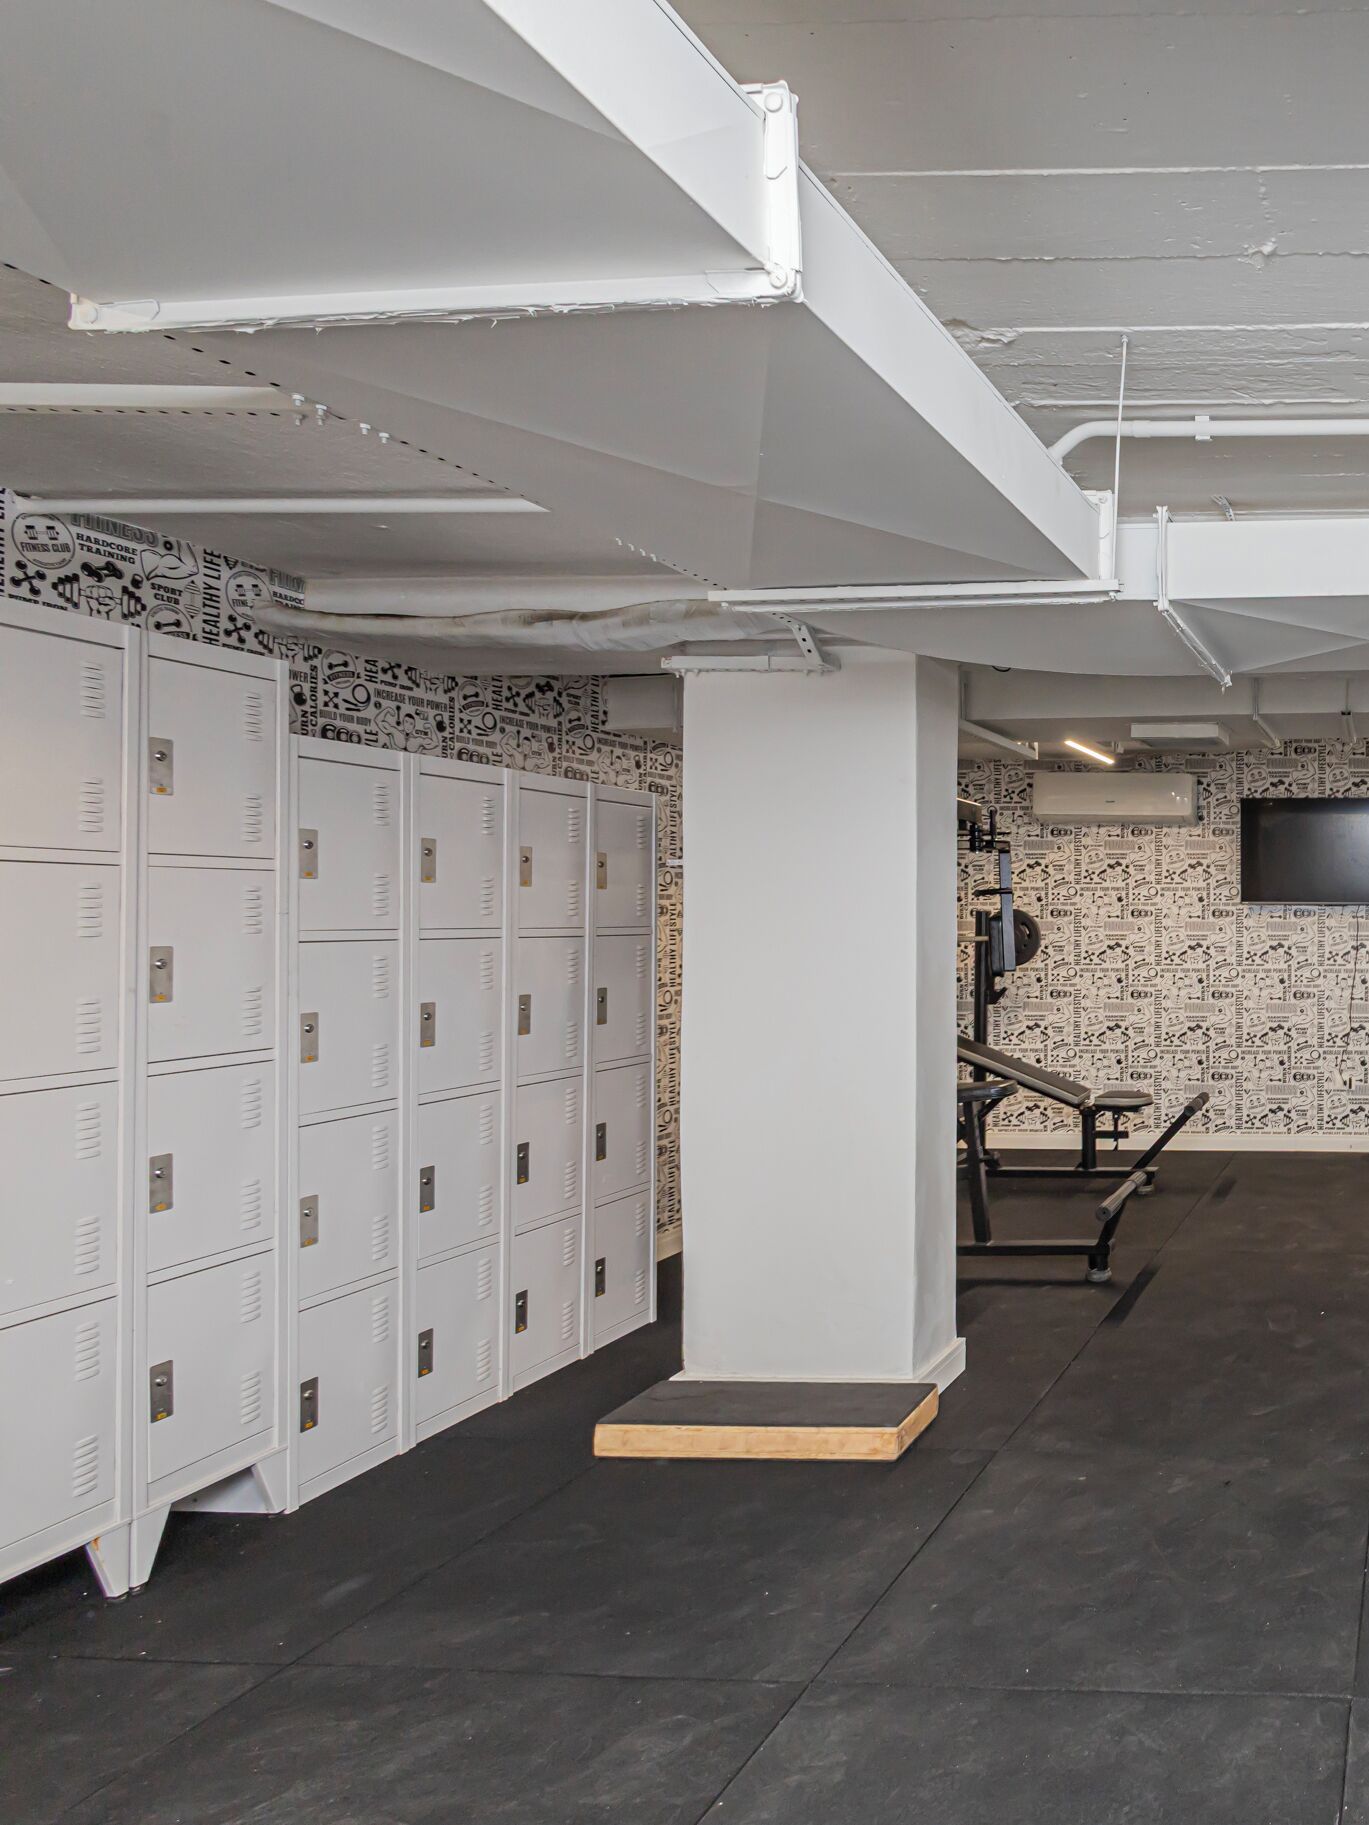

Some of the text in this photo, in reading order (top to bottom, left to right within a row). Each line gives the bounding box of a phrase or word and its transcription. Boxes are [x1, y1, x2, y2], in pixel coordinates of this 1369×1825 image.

[20, 542, 71, 553] FITNESS CLUB
[76, 532, 138, 556] HARDCORE
[78, 543, 136, 565] TRAINING
[151, 582, 183, 597] SPORT
[153, 593, 180, 605] CLUB
[202, 582, 221, 646] HEALTHY
[309, 664, 318, 728] CALORIES
[374, 688, 449, 713] INCREASE YOUR POWER
[492, 675, 503, 711] HEALT
[590, 689, 600, 733] HEALTHY
[448, 696, 456, 751] CALORIES
[500, 715, 557, 735] INCREASE YOUR POWER
[1073, 826, 1082, 885] HEALTHY LIFESTYLE
[1154, 826, 1163, 885] HEALTHY LIFESTYLE
[1073, 907, 1082, 966] HEALTHY LIFESTYLE
[1154, 907, 1163, 966] HEALTHY LIFESTYLE
[1235, 907, 1244, 966] HEALTHY LIFESTYLE
[1317, 907, 1326, 966] HEALTHY LIFESTYLE
[1072, 988, 1081, 1047] HEALTHY LIFESTYLE
[1153, 989, 1162, 1048] HEALTHY LIFESTYLE
[1234, 989, 1243, 1048] HEALTHY LIFESTYLE
[1316, 989, 1325, 1048] HEALTHY LIFESTYLE
[1153, 1070, 1162, 1129] HEALTHY LIFESTYLE
[1234, 1071, 1243, 1130] HEALTHY LIFESTYLE
[1316, 1071, 1325, 1130] HEALTHY LIFESTYLE
